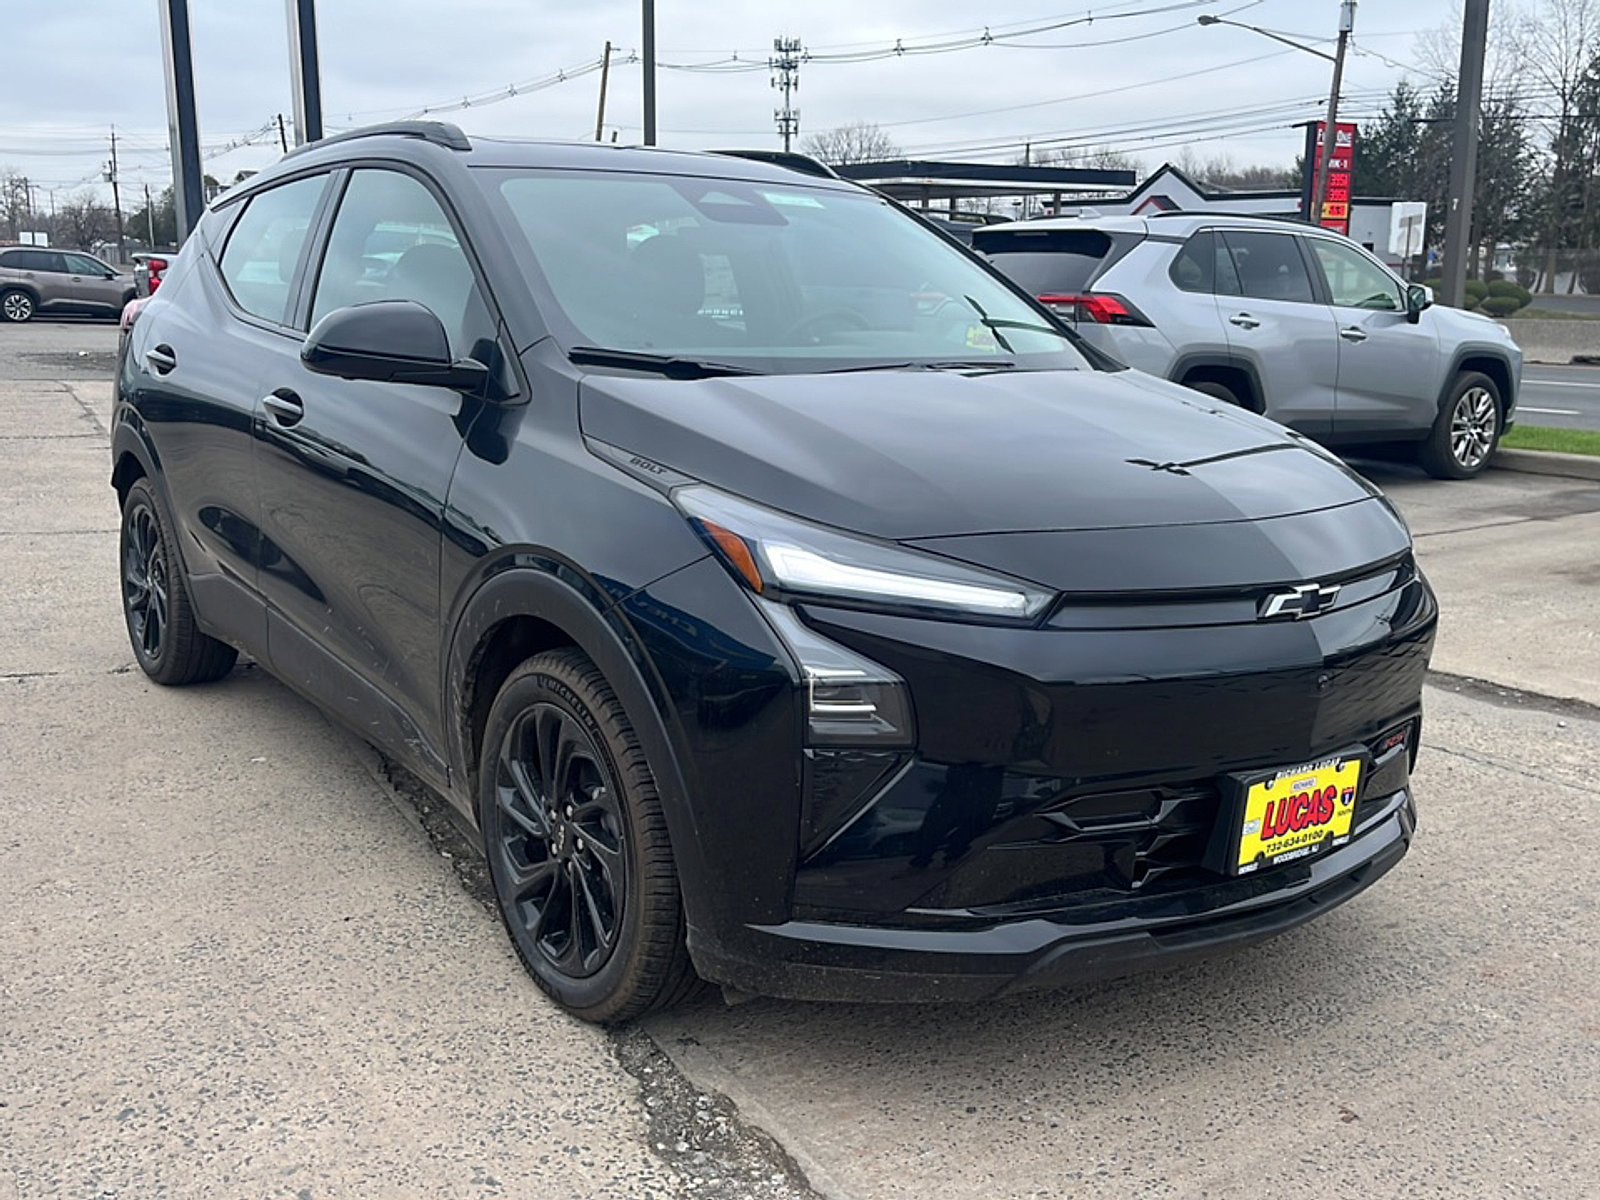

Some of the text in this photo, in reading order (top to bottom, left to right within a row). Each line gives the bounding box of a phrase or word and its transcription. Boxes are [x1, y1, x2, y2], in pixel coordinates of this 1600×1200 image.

[630, 457, 668, 475] BOLT
[546, 677, 595, 729] MICHELIN
[1276, 764, 1314, 780] RICHARD
[1260, 785, 1338, 841] LUCAS
[1266, 829, 1324, 854] 732-634-0100
